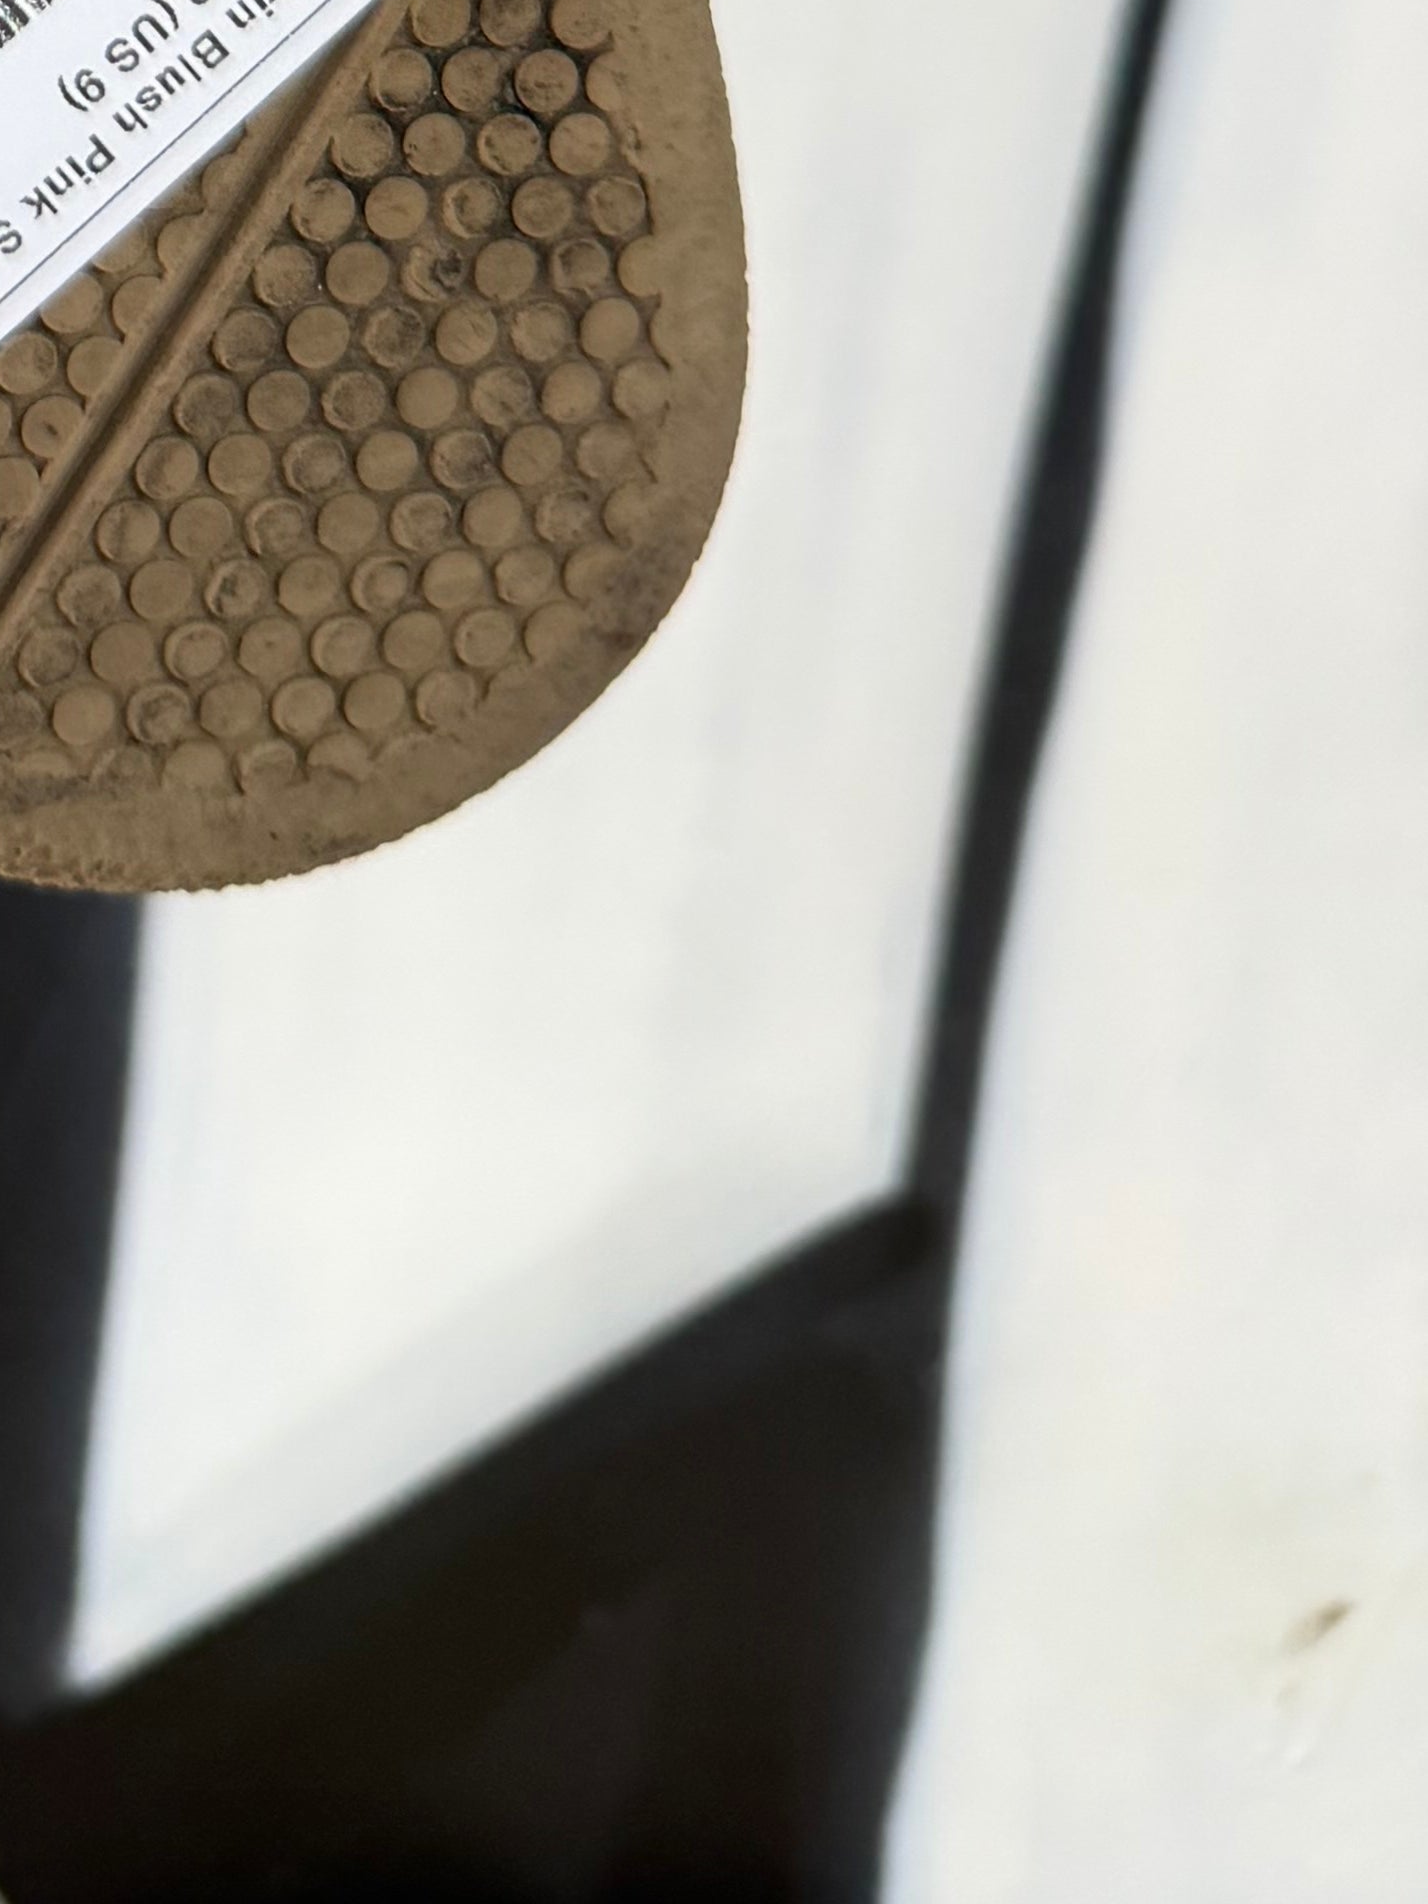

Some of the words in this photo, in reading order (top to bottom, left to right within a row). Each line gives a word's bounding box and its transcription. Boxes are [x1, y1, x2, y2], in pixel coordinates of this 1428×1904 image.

[57, 68, 106, 112] 9)
[112, 28, 230, 133] Blush
[19, 133, 116, 219] Pink
